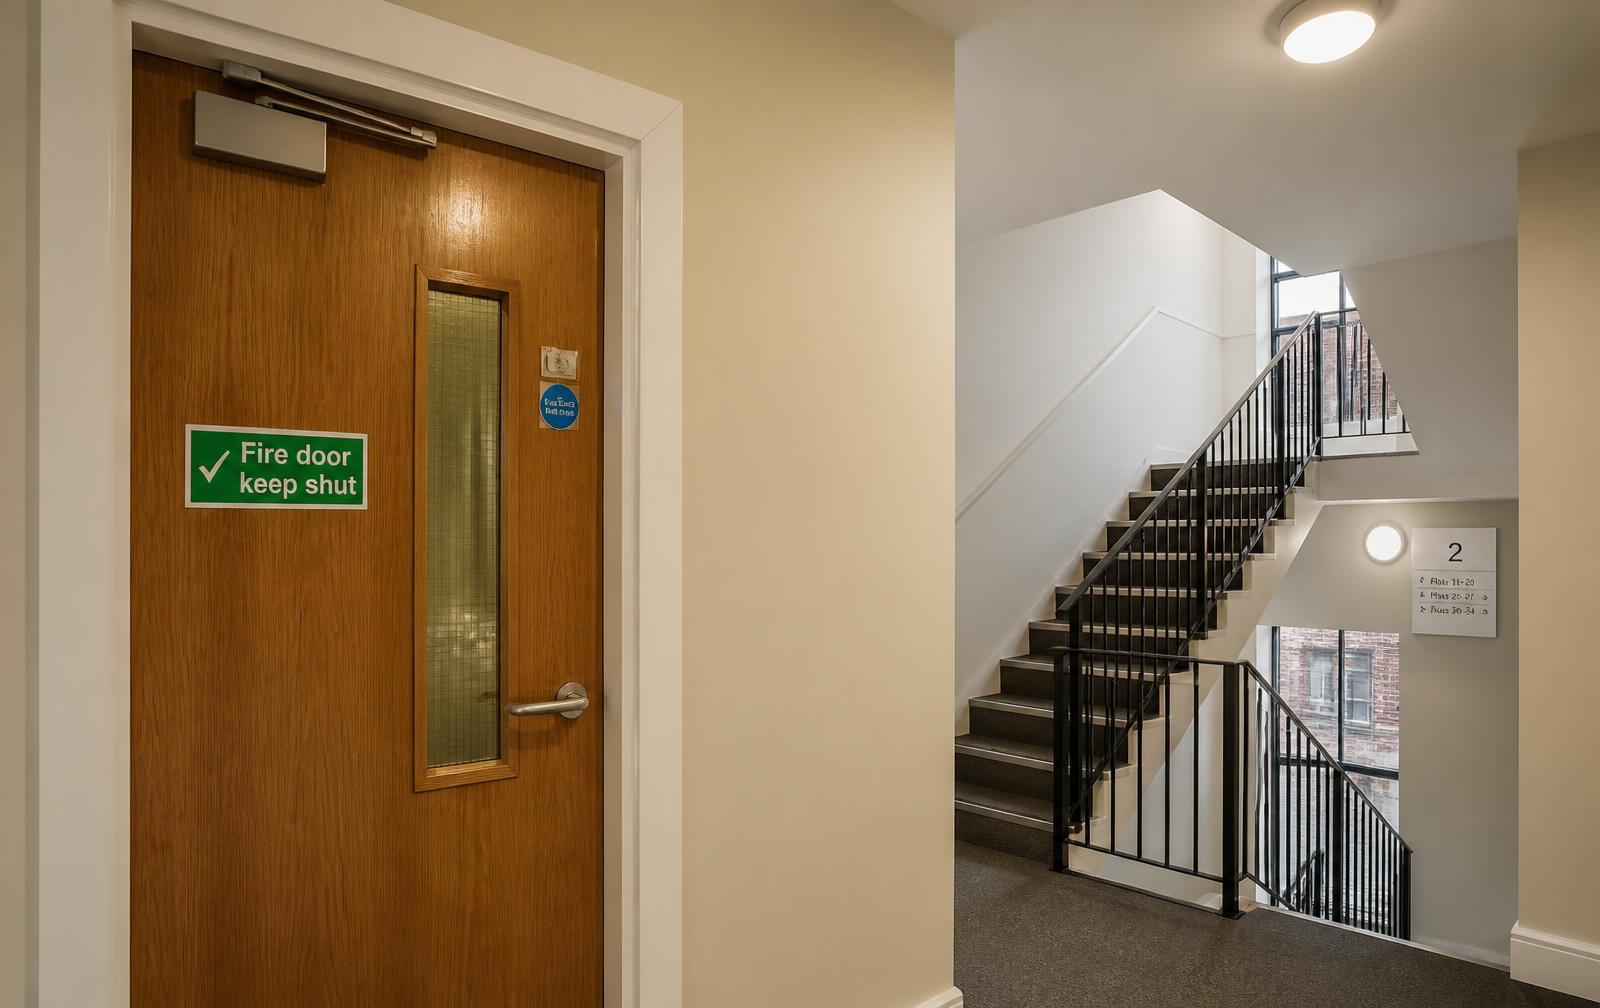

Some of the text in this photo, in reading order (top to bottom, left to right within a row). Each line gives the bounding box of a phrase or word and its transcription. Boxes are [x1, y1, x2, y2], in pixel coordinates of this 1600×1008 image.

[241, 441, 352, 467] Fire door
[239, 471, 357, 500] keep shut
[1448, 542, 1463, 562] 2
